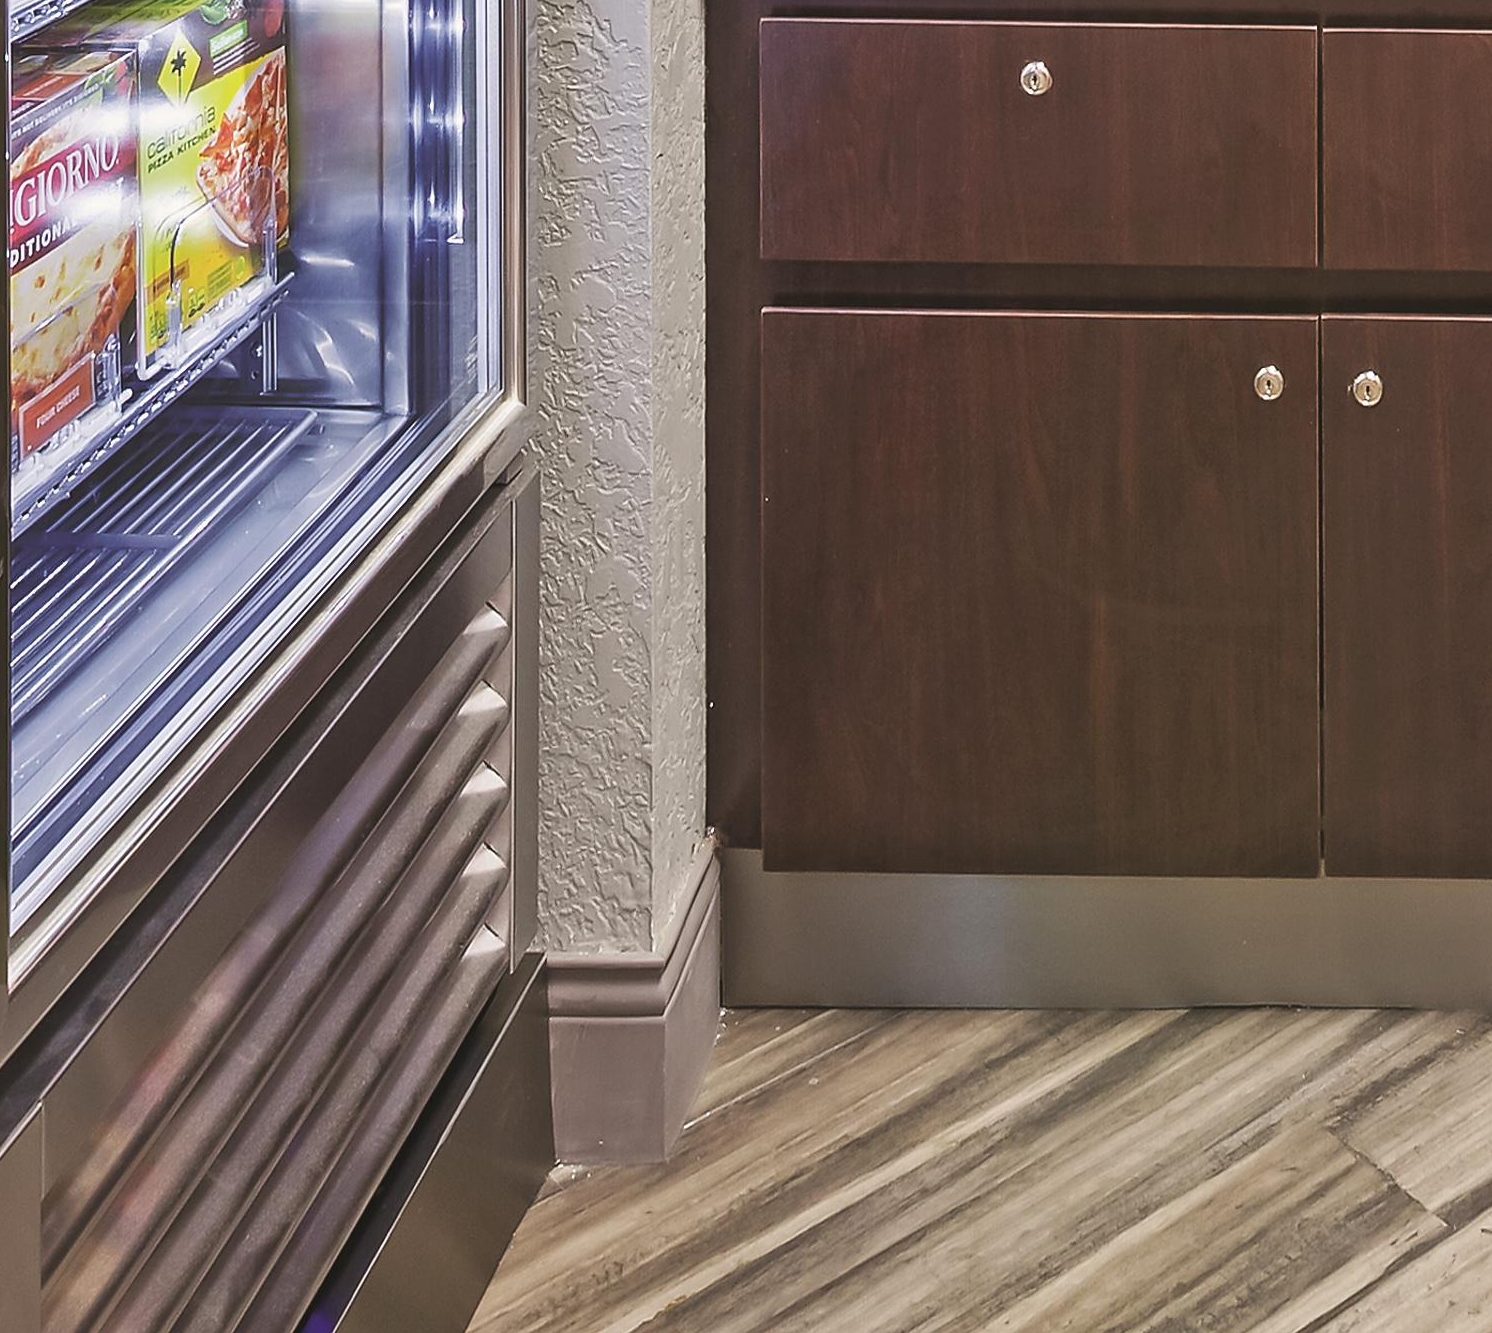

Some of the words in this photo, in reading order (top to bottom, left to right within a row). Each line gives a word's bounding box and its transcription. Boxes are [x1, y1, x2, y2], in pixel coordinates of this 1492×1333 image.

[148, 149, 174, 173] PIZZA
[177, 124, 216, 159] KITCHEN
[36, 406, 57, 429] FOUR
[58, 386, 81, 418] CHEESE
